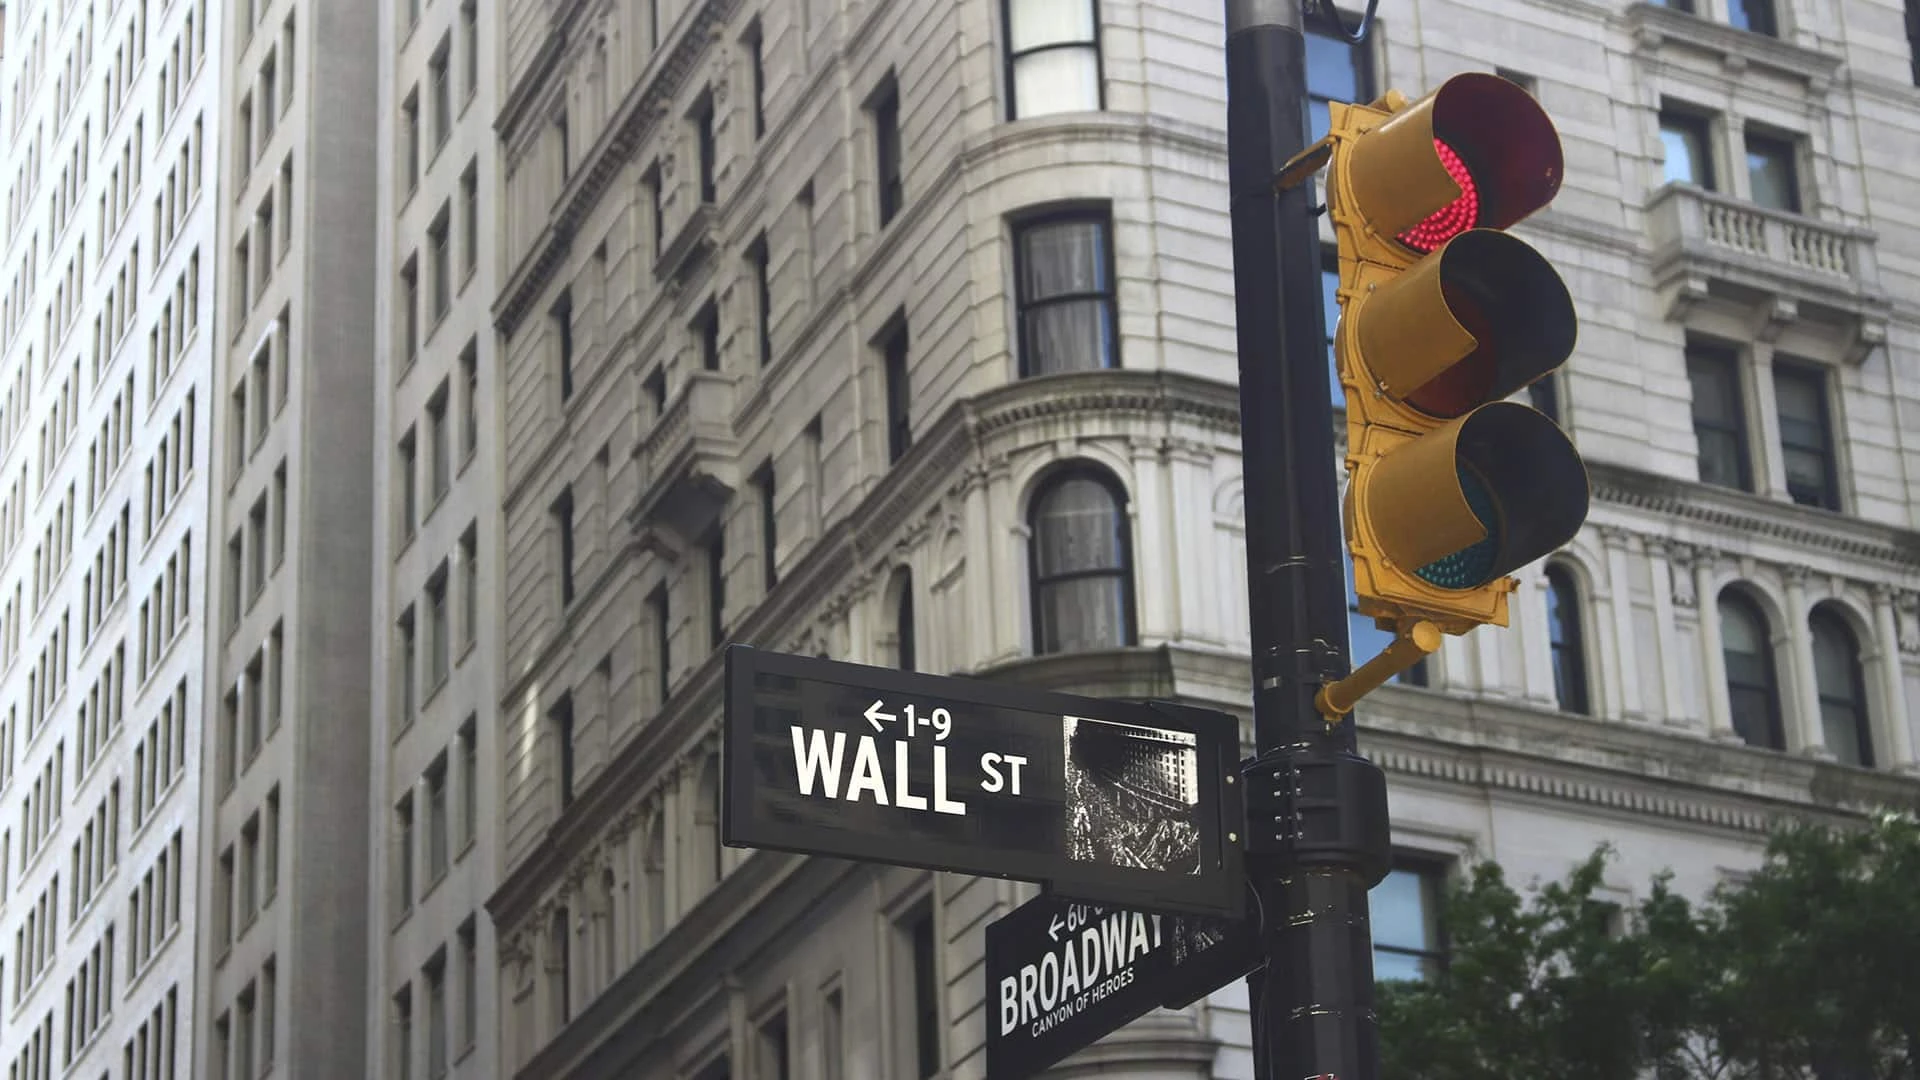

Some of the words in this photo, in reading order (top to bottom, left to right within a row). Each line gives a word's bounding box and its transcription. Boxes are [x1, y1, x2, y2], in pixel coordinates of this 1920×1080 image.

[903, 703, 952, 741] 1-9
[790, 725, 966, 816] WALL
[980, 752, 1028, 796] ST
[1000, 910, 1161, 1037] BROADWAY
[1031, 1001, 1074, 1039] CANYON
[1075, 990, 1091, 1014] OF
[1091, 966, 1134, 1005] HEROES
